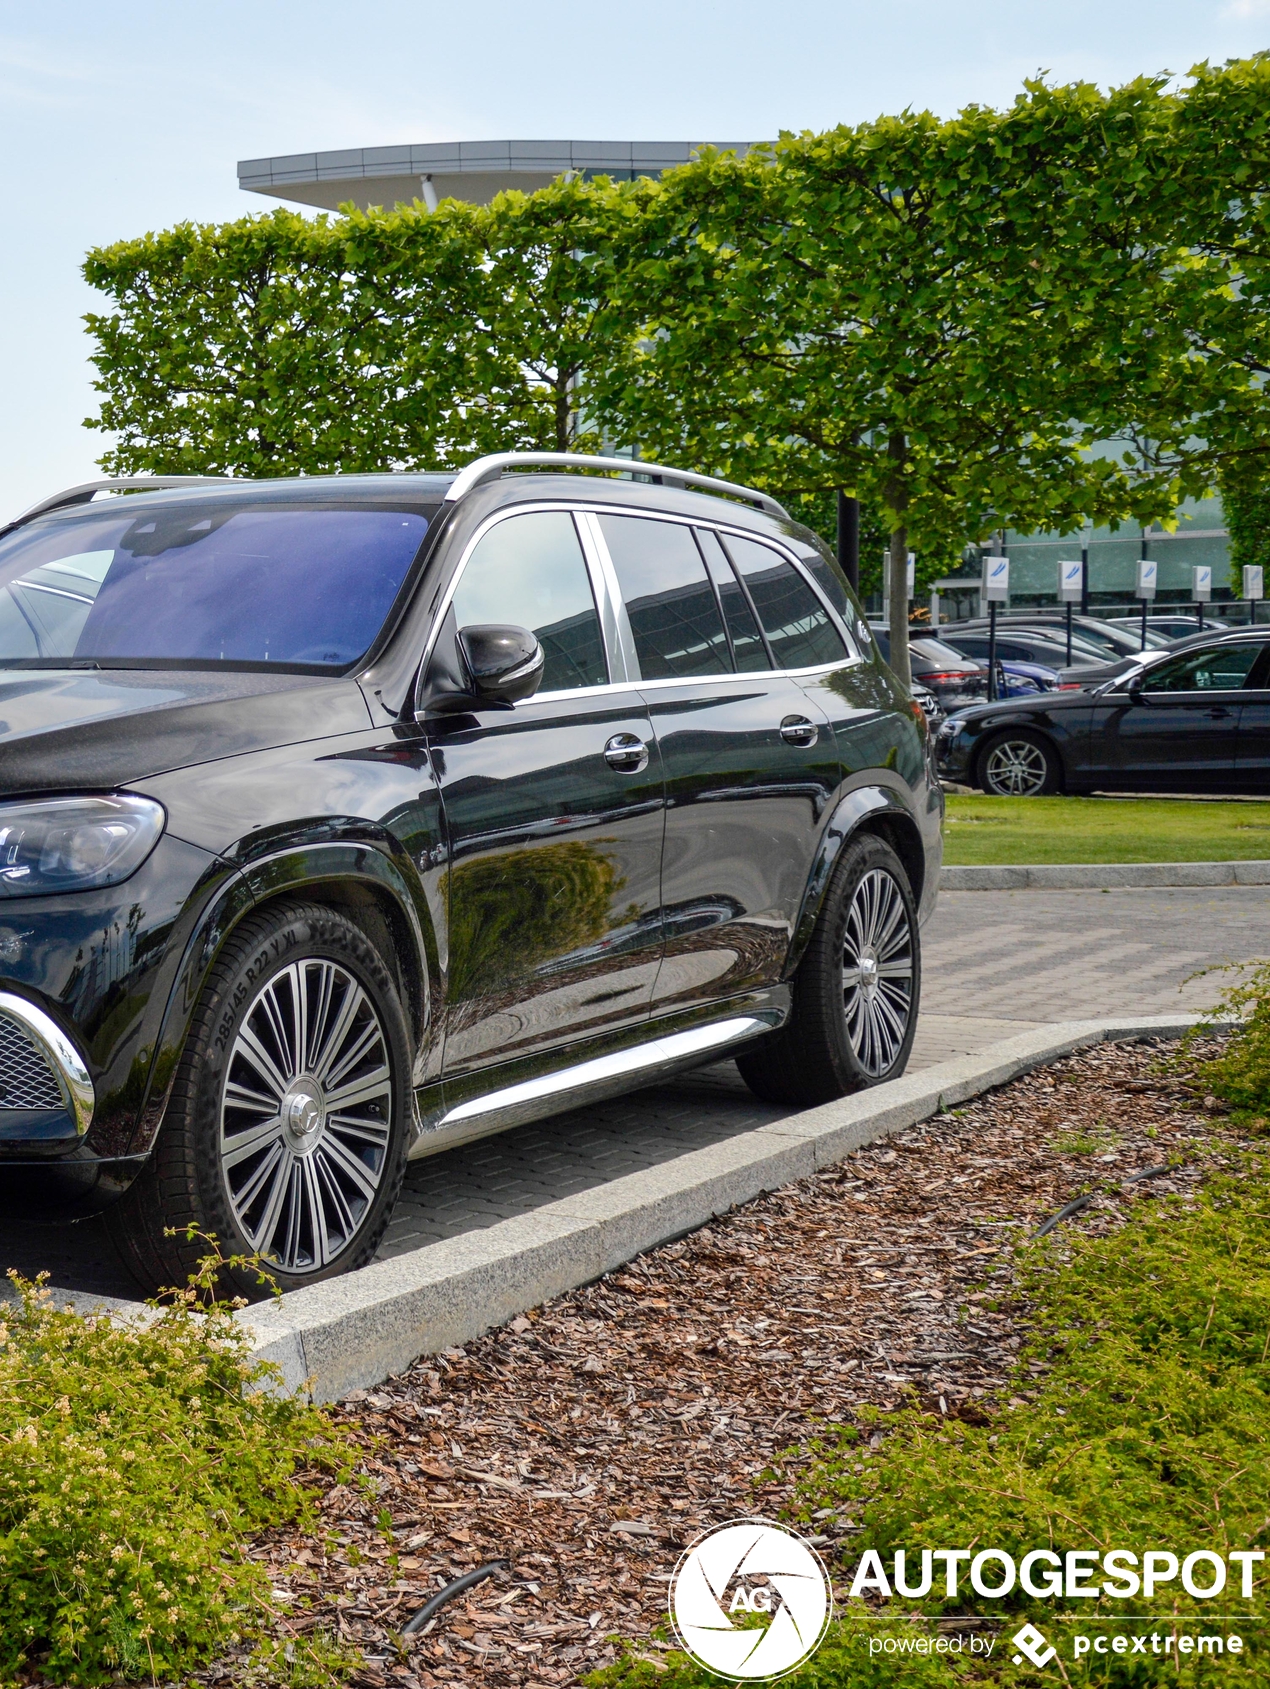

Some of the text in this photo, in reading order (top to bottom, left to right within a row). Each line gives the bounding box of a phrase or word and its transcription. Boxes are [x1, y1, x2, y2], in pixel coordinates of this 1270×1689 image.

[214, 982, 248, 1051] 285/45
[245, 967, 258, 984] R
[254, 950, 271, 974] 22
[282, 929, 300, 949] XL
